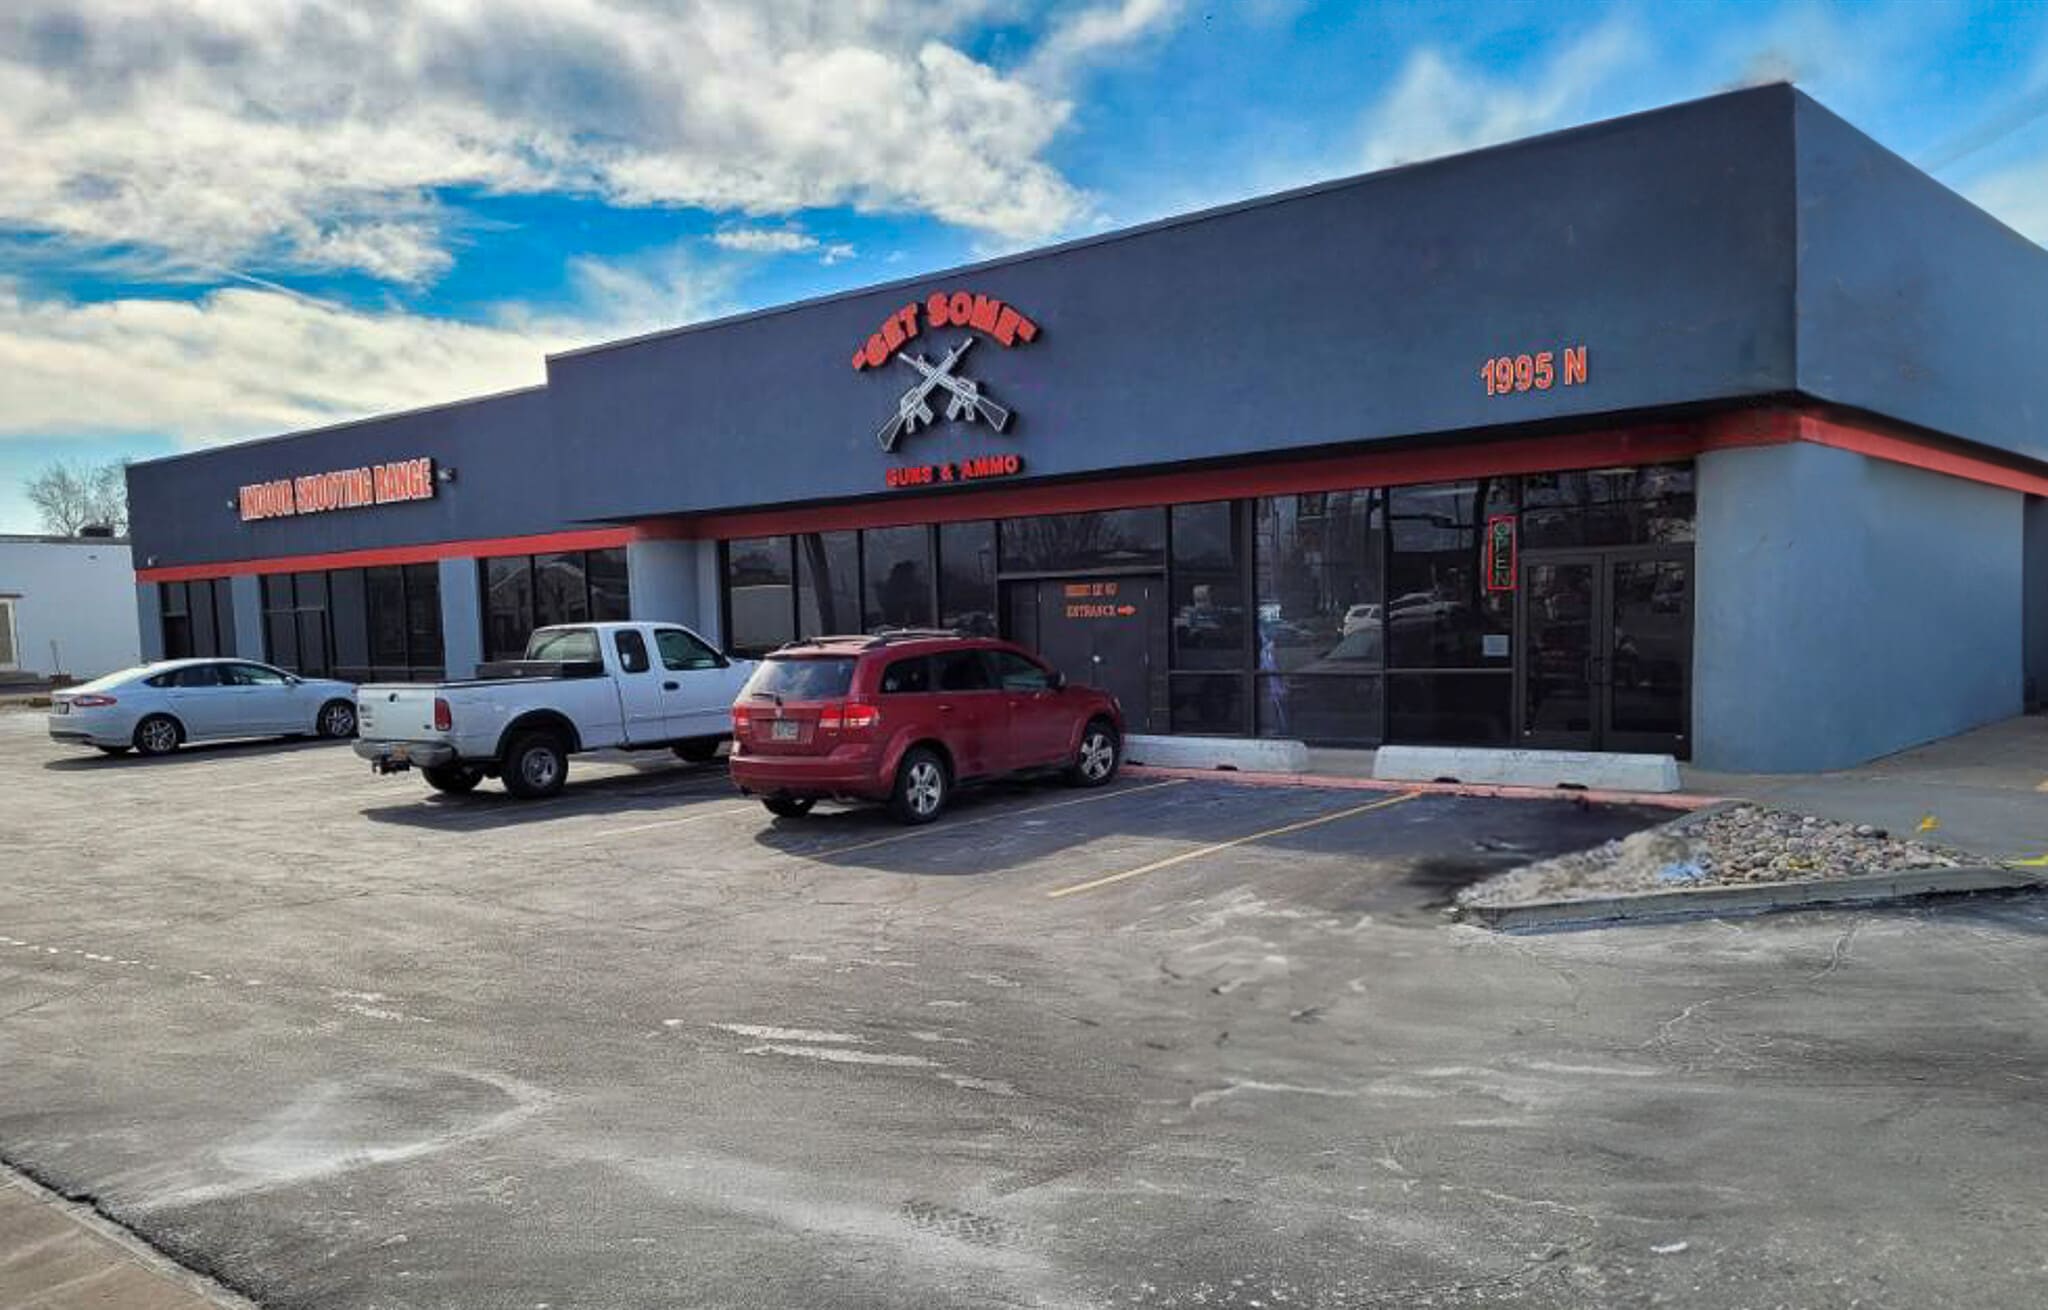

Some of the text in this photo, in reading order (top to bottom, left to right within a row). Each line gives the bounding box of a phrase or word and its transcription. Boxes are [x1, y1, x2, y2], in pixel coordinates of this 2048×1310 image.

[1481, 345, 1587, 396] 1995 N
[239, 457, 433, 521] INDOOR SHOOTING RANGE
[886, 455, 1020, 488] GUNS & AMMO
[1494, 521, 1511, 586] OPEN
